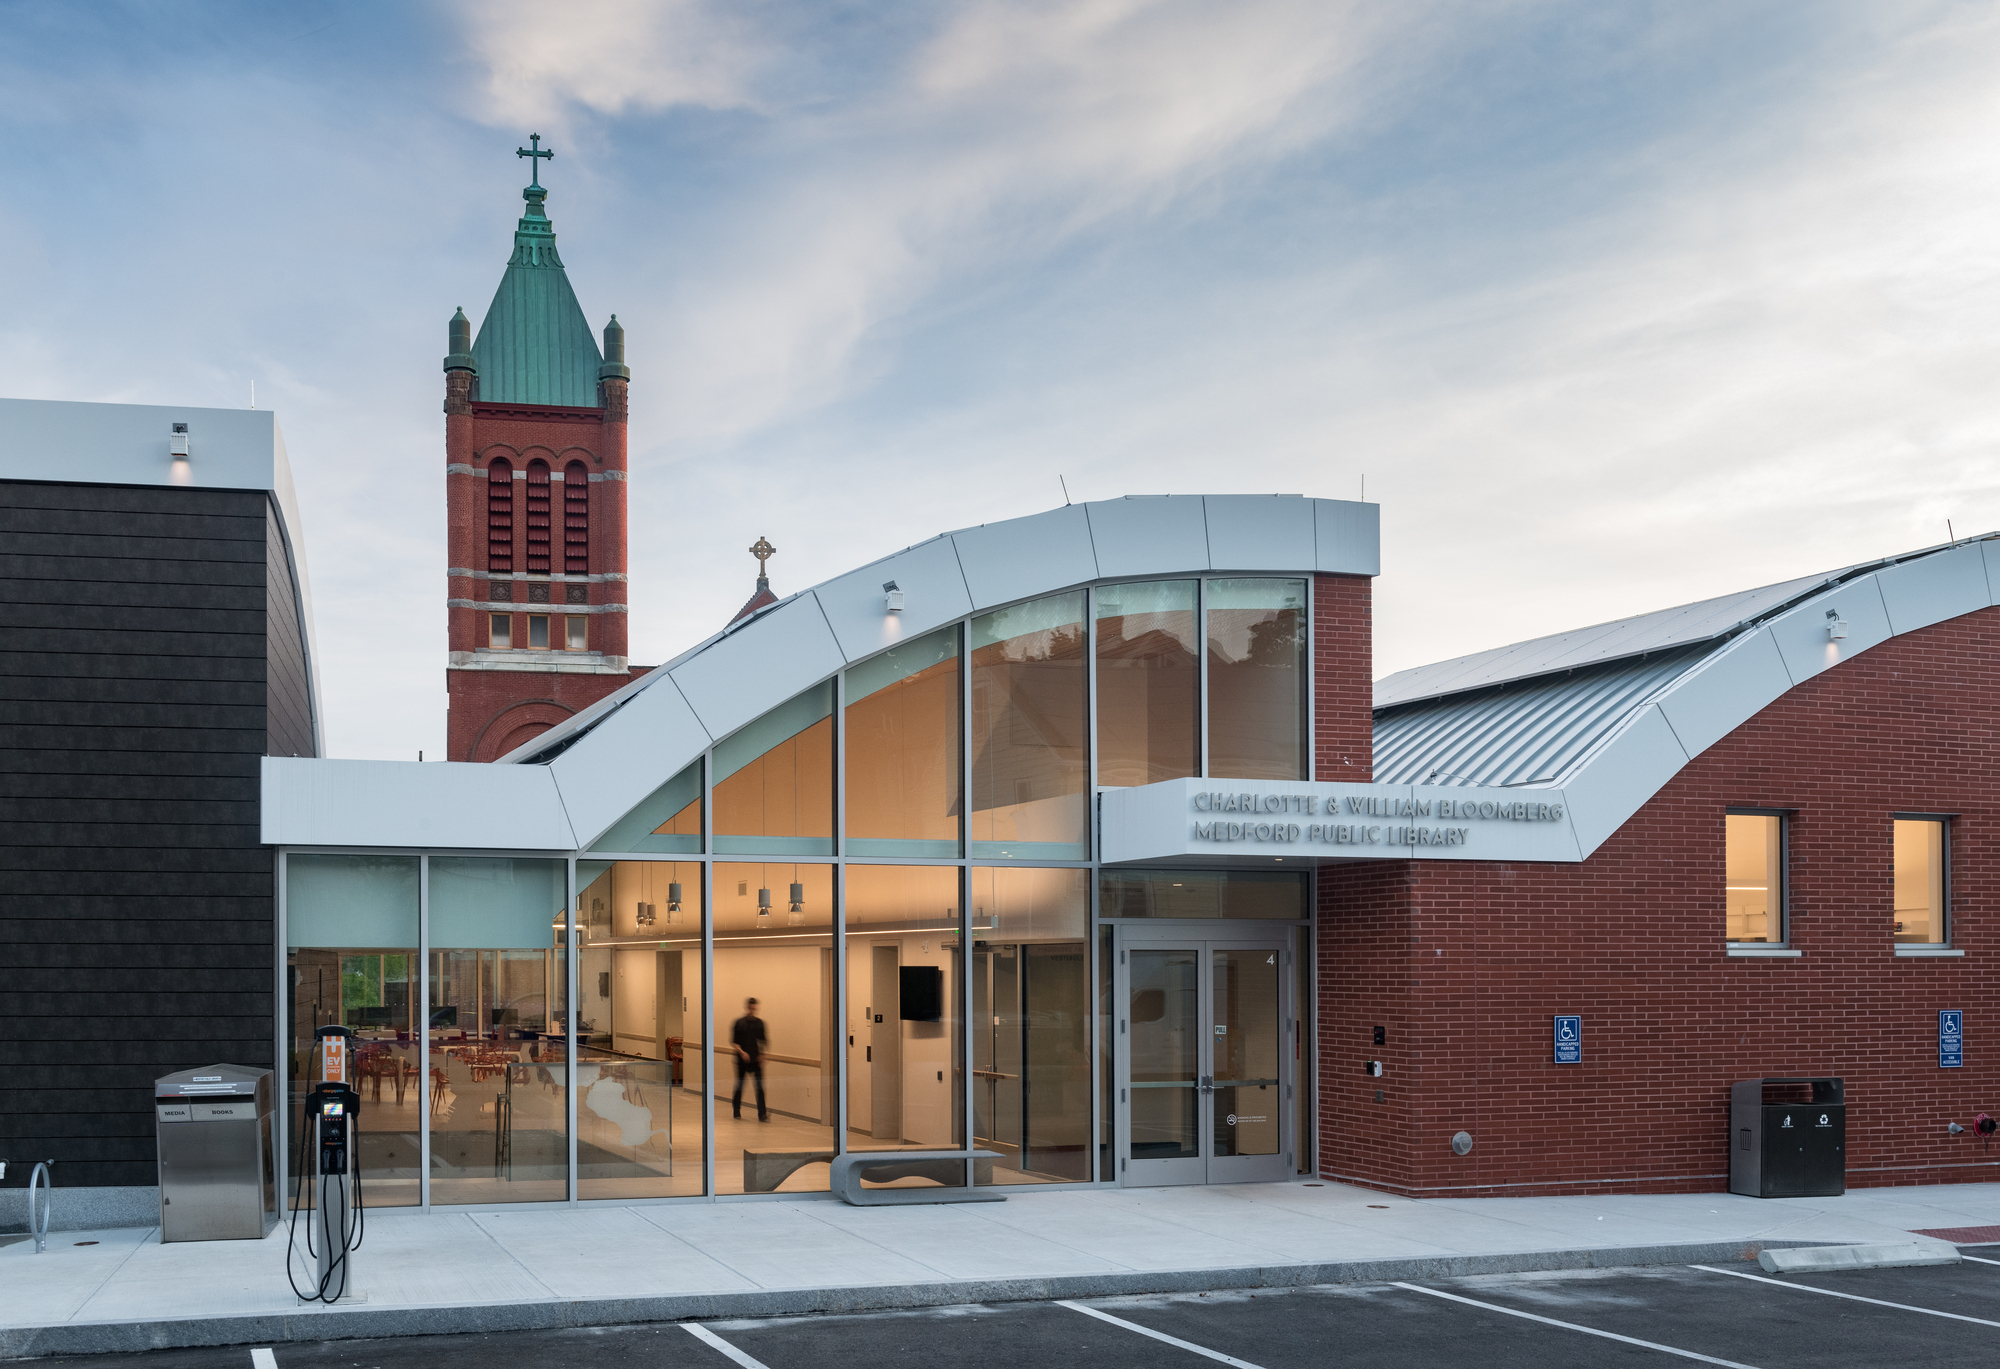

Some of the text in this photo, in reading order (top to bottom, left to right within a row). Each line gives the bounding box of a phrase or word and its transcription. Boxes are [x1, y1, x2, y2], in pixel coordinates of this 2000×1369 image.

[1194, 792, 1564, 821] CHARLOTTE & WILLIAM BLOOMBERG
[1195, 821, 1470, 846] MEDFORD PUBLIC LIBRARY
[1266, 954, 1275, 965] 4
[327, 1057, 340, 1065] EV
